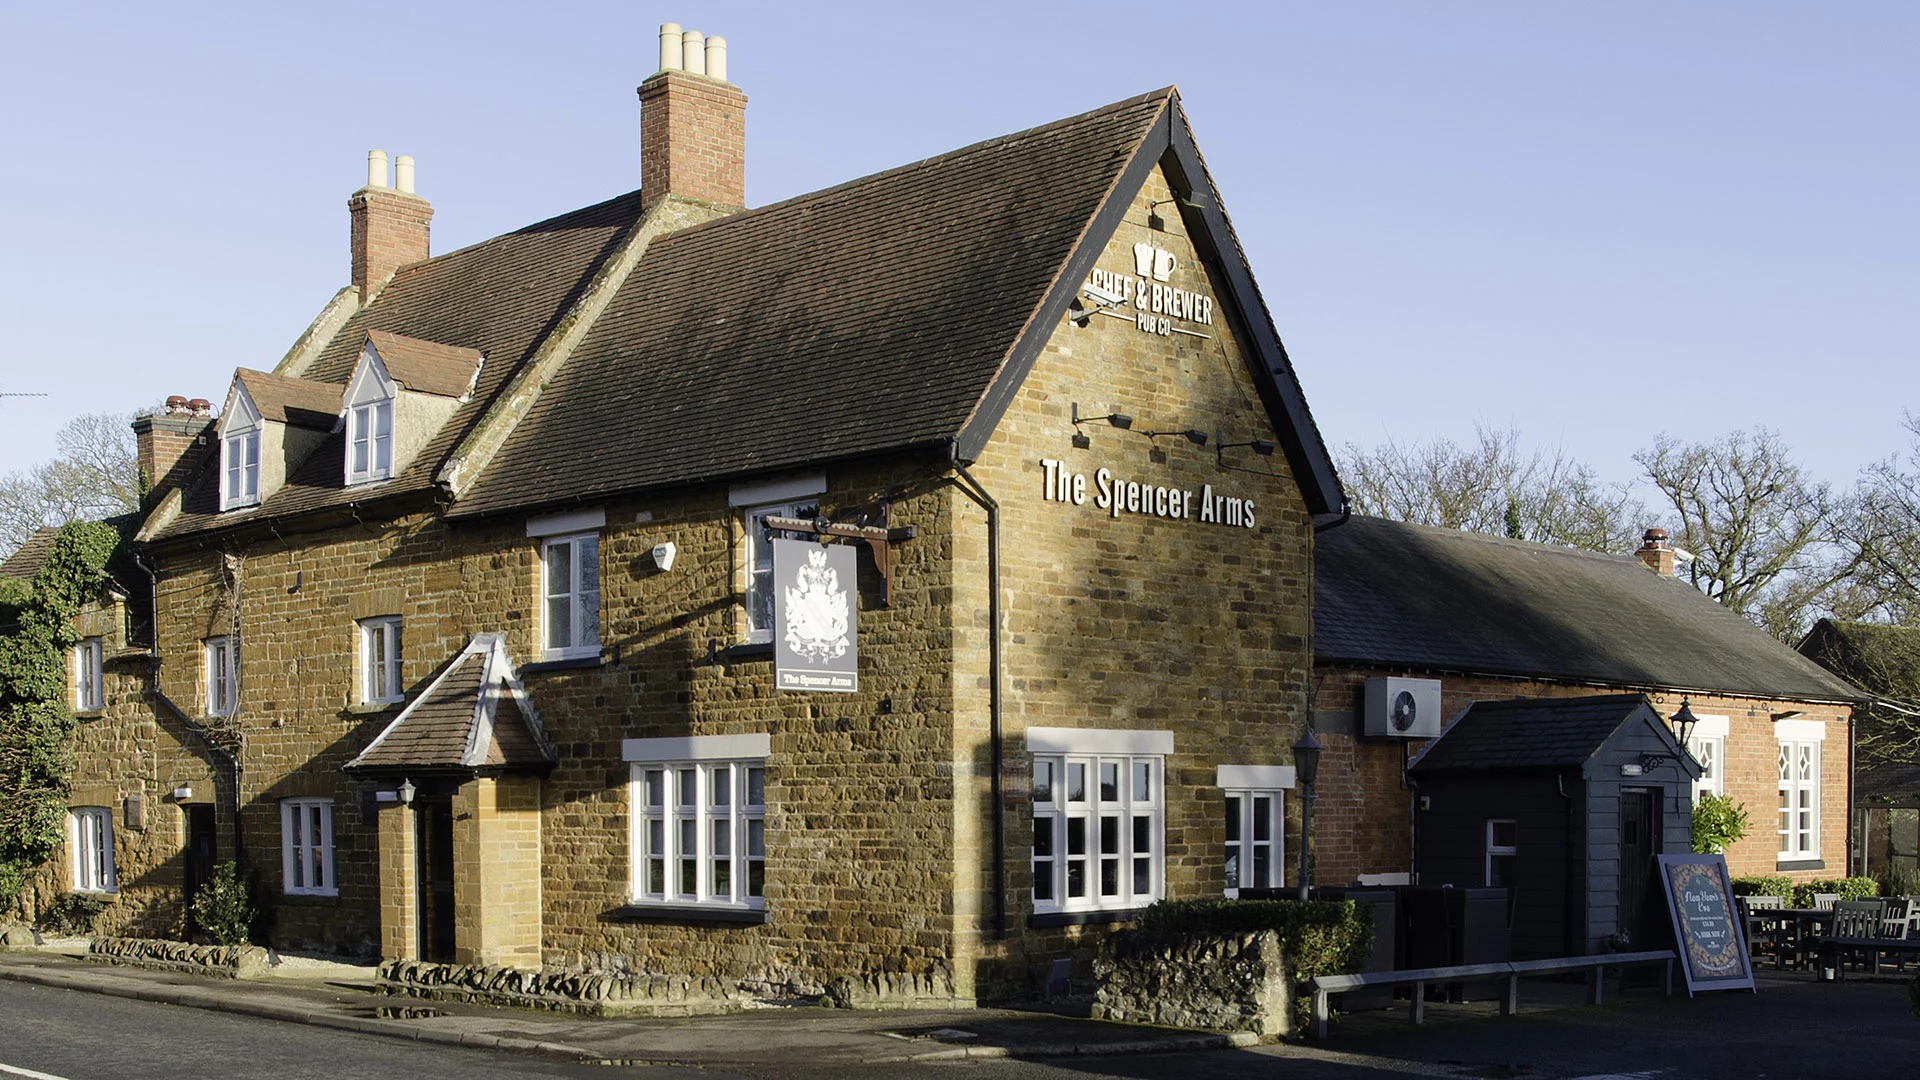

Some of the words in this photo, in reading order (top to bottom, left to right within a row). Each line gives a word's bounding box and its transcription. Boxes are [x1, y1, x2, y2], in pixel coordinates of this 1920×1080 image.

[1091, 268, 1132, 301] CHEF
[1135, 280, 1148, 310] &
[1152, 283, 1212, 325] BREWER
[1137, 313, 1156, 333] PUB
[1157, 317, 1170, 336] CO
[1041, 459, 1086, 505] The
[1095, 467, 1192, 518] Spencer
[1200, 484, 1256, 528] Arms
[783, 674, 799, 684] The
[800, 674, 831, 687] Spencer
[831, 676, 852, 686] Arms
